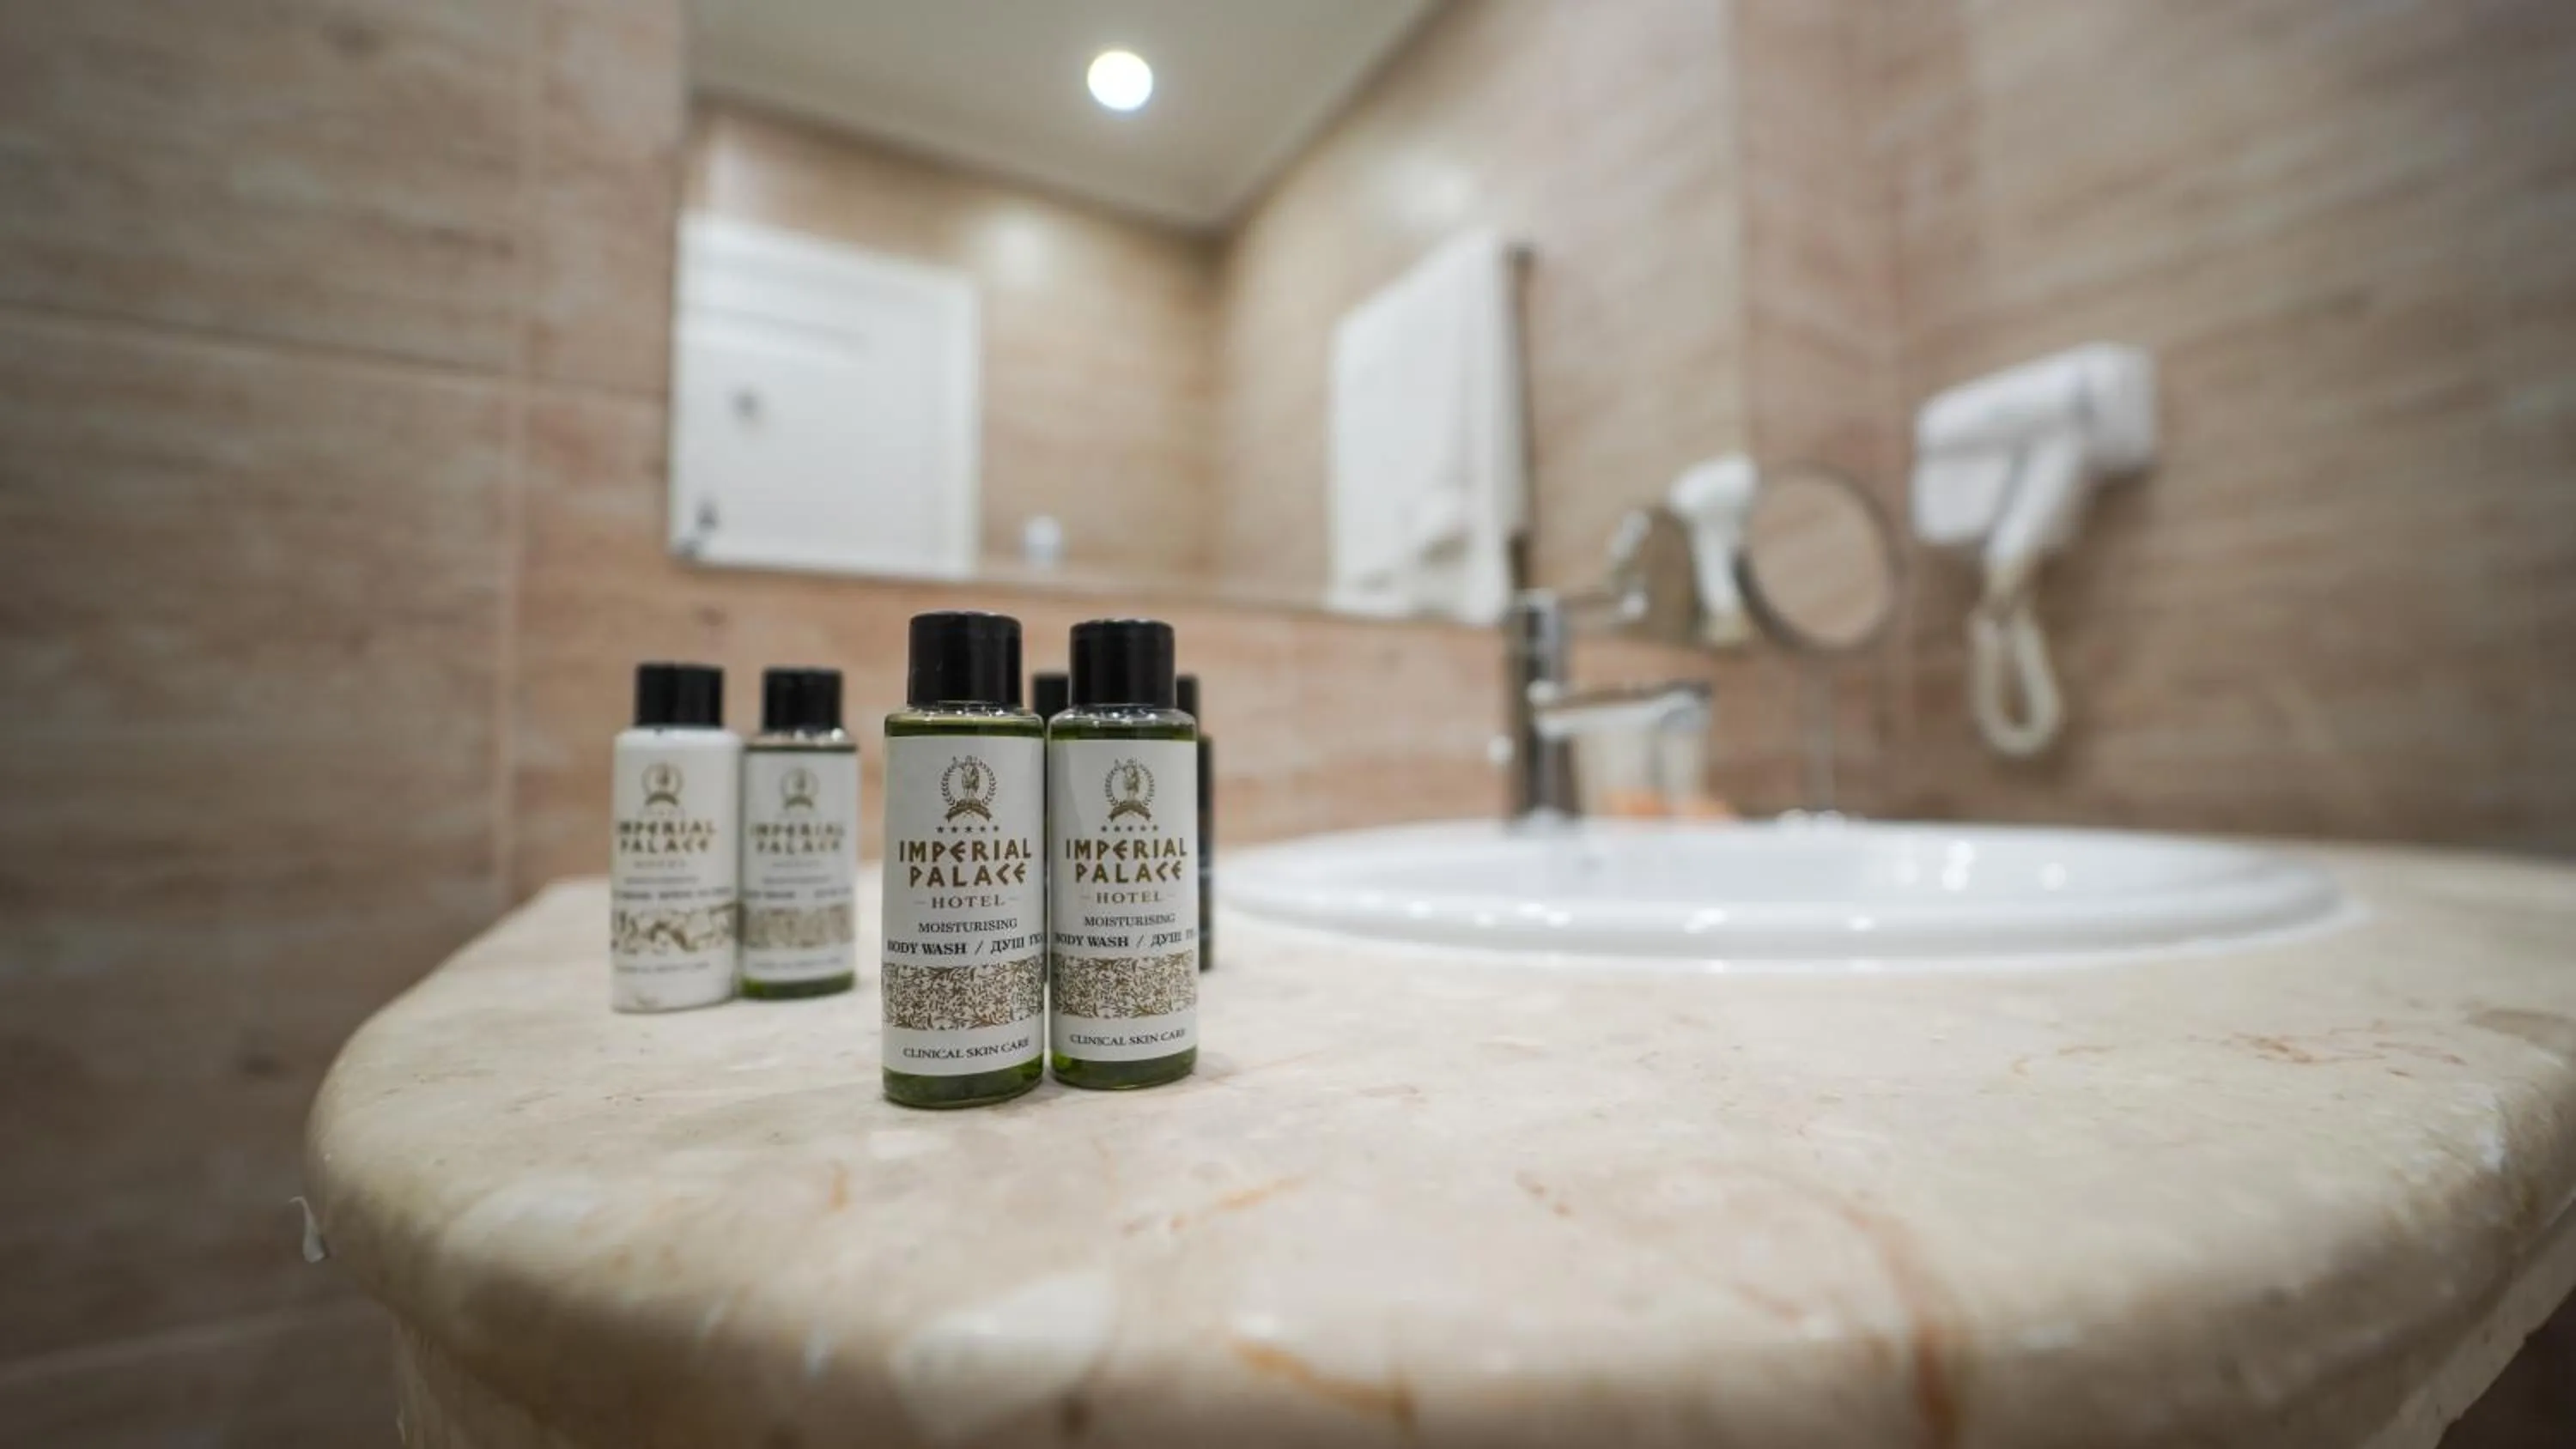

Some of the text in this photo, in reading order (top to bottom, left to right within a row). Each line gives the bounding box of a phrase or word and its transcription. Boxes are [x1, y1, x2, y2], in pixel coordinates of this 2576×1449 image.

[616, 820, 716, 836] MPERIAL
[899, 838, 1032, 863] IMPERIAL
[1066, 838, 1188, 861] IMPERIAL
[910, 863, 1026, 888] PALACE
[1075, 860, 1182, 883] PALACE
[931, 894, 1005, 909] HOTEL
[1097, 890, 1162, 904] HOTEL
[918, 918, 1018, 934] MOISTURISING
[1084, 912, 1176, 928] MOISTURISING
[921, 942, 967, 955] WASH
[1087, 934, 1129, 948] WASH
[1128, 1032, 1158, 1046] SKIN
[902, 1046, 963, 1060] CLINICAL
[965, 1044, 999, 1058] SKIN
